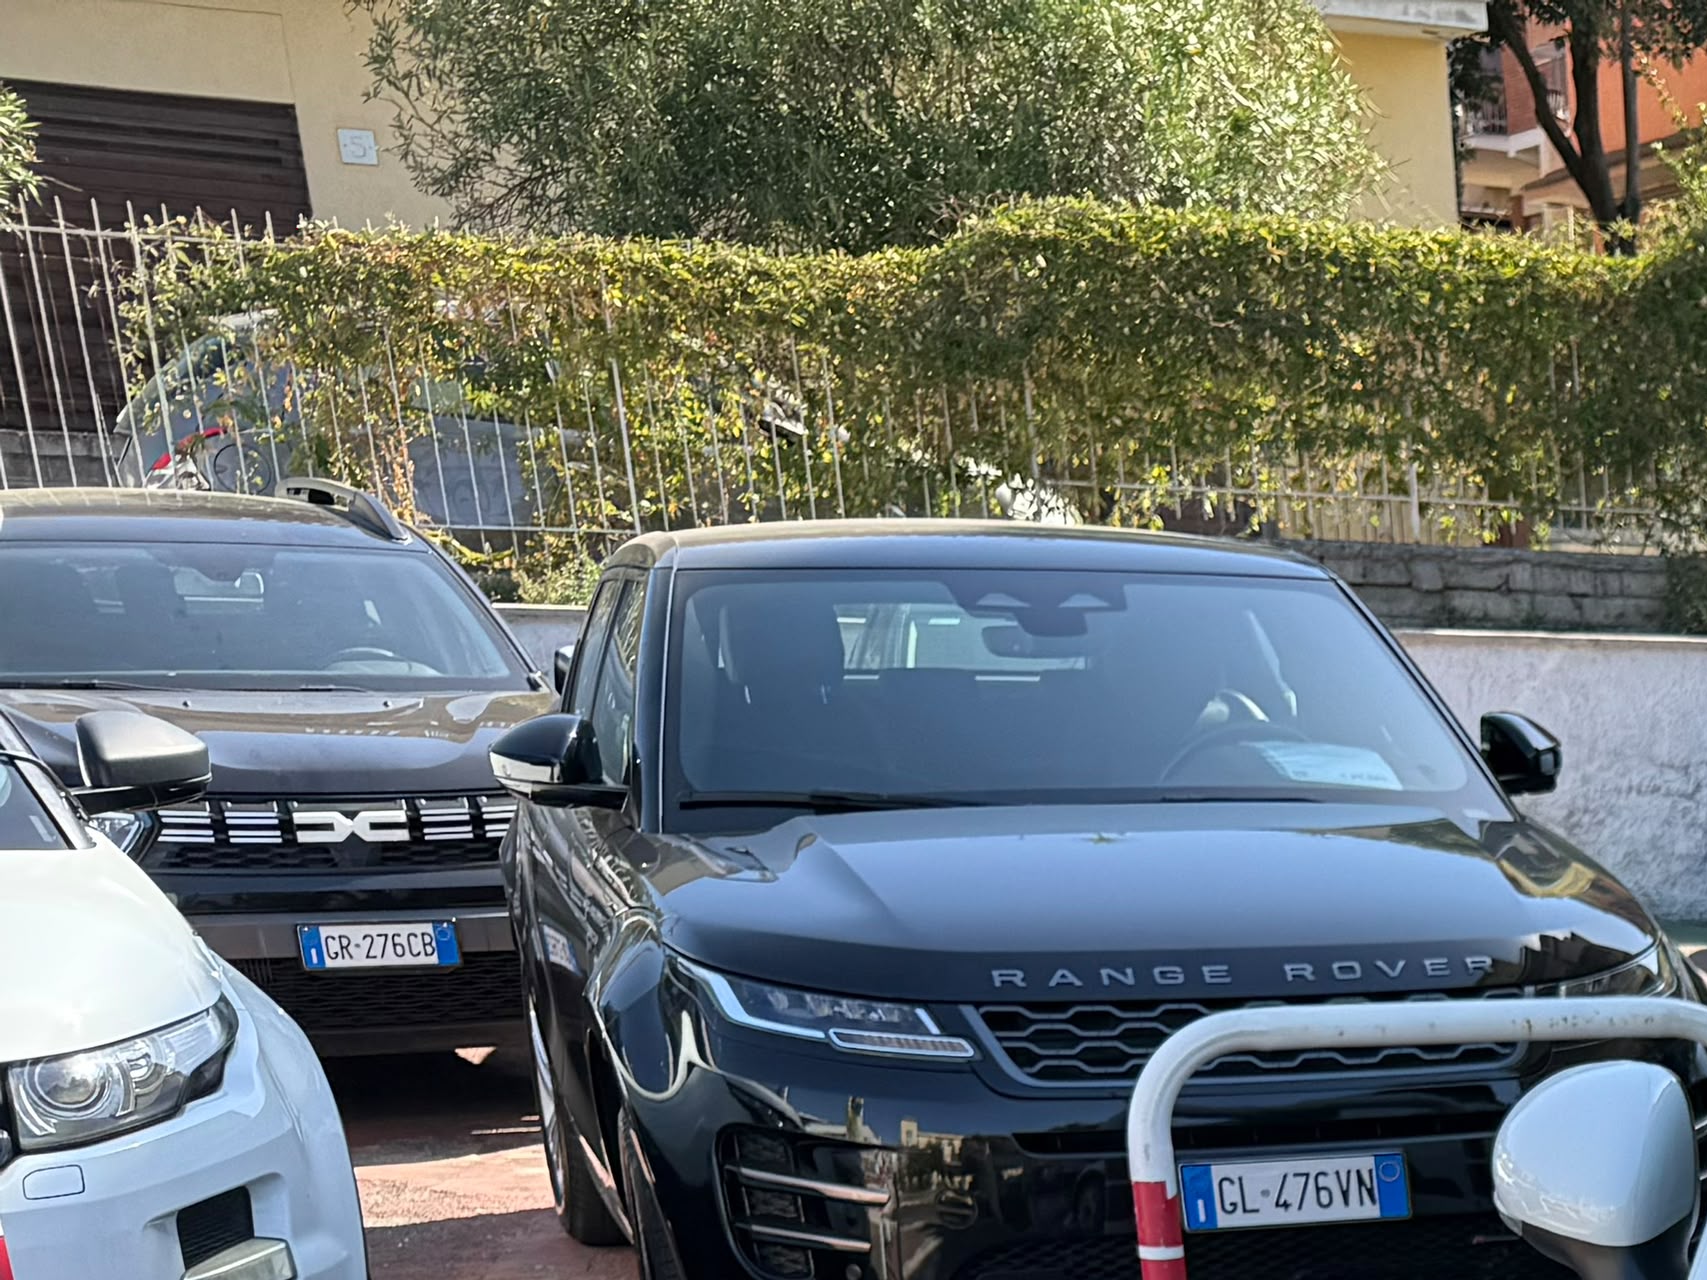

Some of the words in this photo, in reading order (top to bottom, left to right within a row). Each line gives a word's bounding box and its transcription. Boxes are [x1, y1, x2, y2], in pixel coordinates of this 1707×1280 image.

[324, 935, 353, 960] GR
[362, 932, 436, 959] 276CB
[992, 965, 1232, 988] RANGE
[1284, 956, 1493, 982] ROVER
[1218, 1175, 1260, 1214] GL
[1274, 1168, 1377, 1211] 476VN
